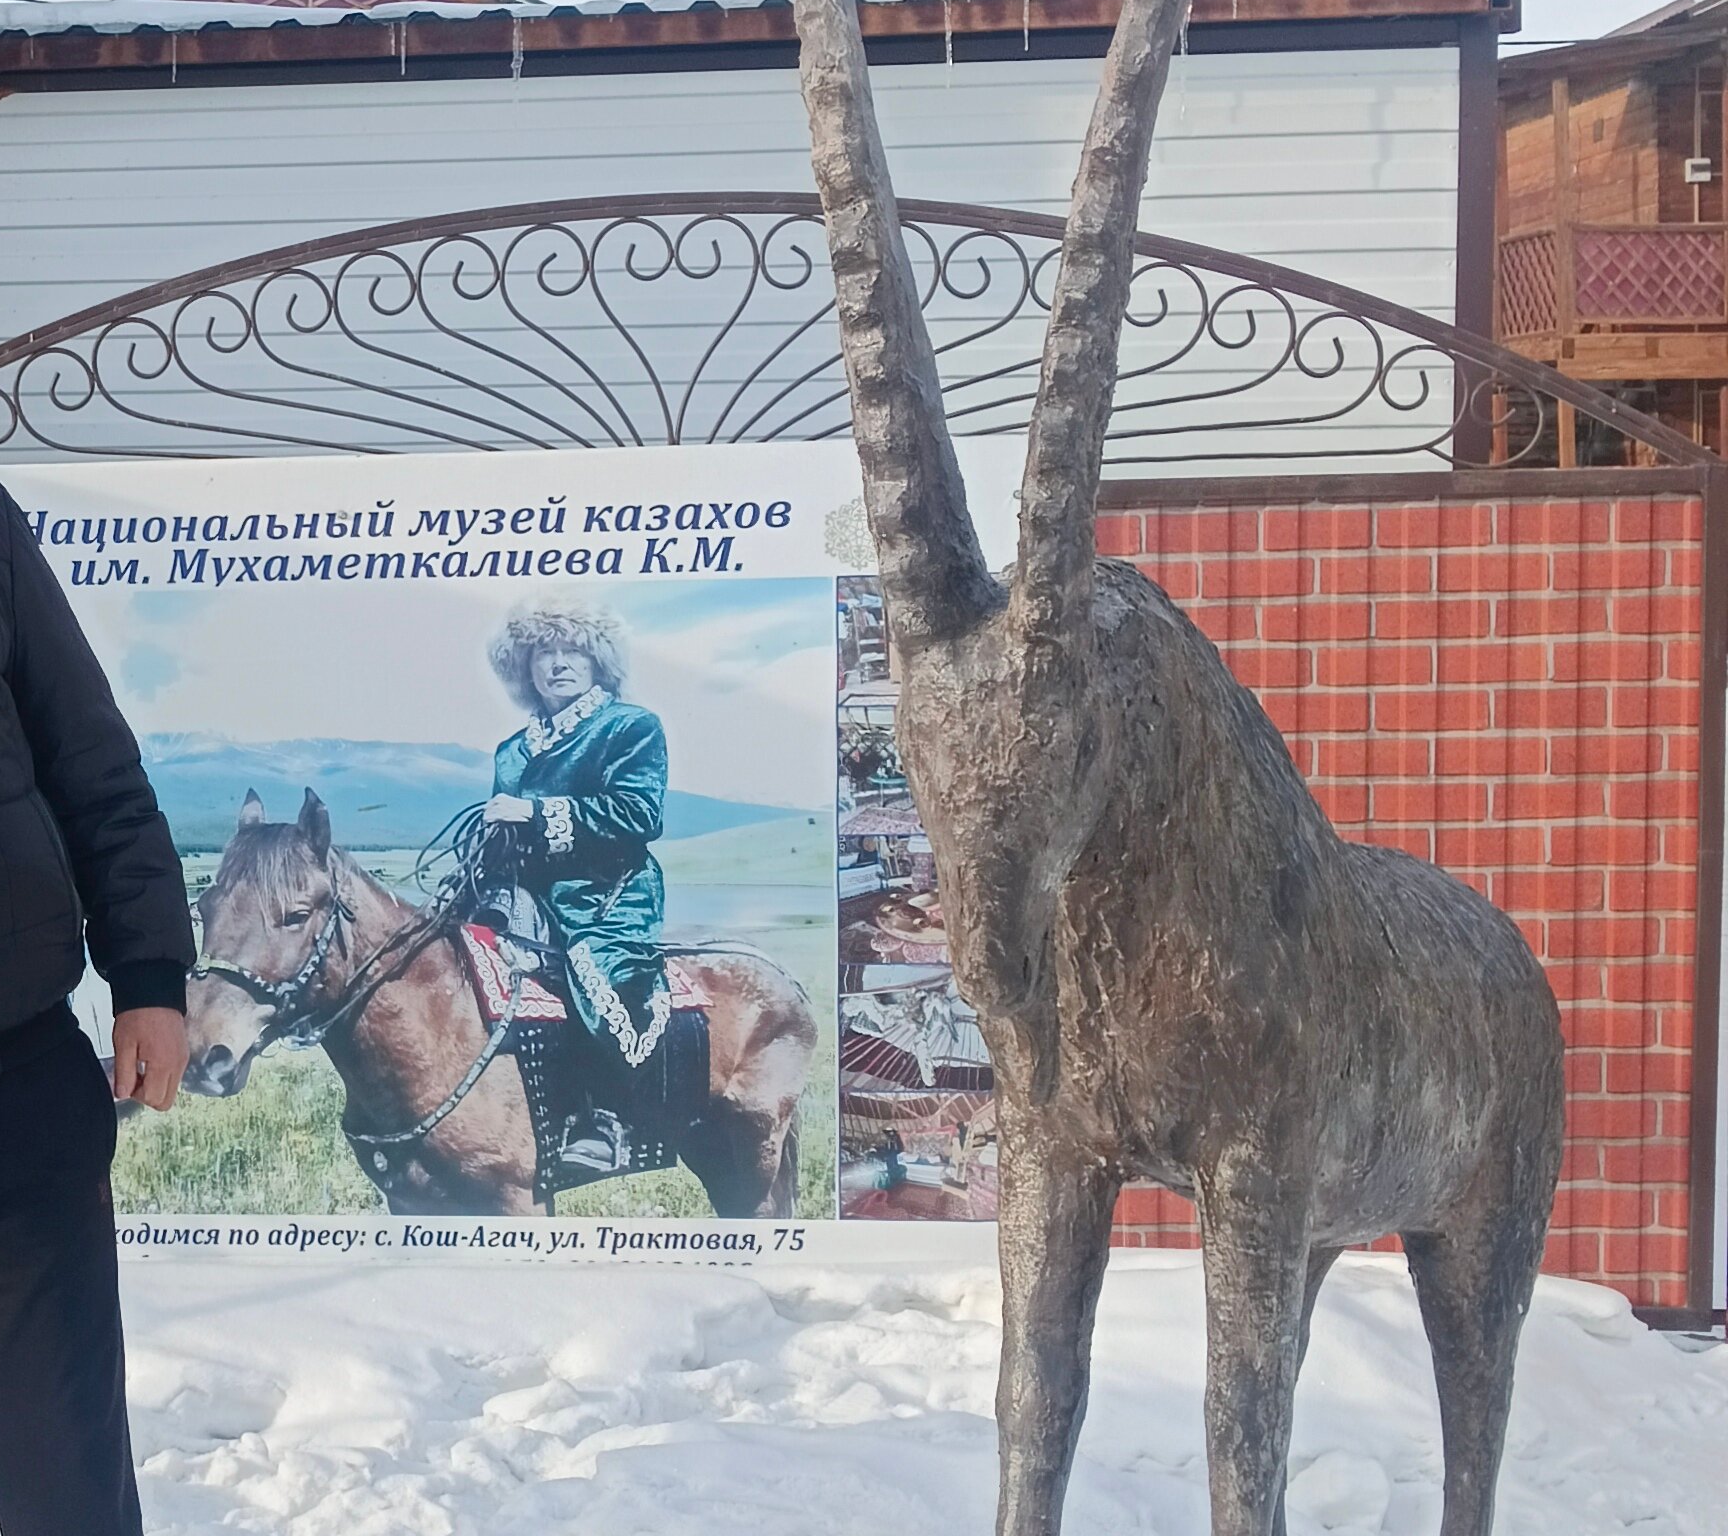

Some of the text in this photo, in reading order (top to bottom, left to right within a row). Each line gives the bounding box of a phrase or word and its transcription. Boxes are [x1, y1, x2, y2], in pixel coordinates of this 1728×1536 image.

[408, 495, 567, 546] музей
[583, 501, 792, 533] казахов
[71, 536, 744, 587] им. Мухаметкалиева К.М.
[228, 1227, 260, 1246] по
[268, 1223, 367, 1252] адресу:
[374, 1229, 393, 1247] с.
[401, 1224, 541, 1252] Кош-Агач,
[546, 1231, 585, 1254] ул.
[596, 1226, 764, 1255] Трактовая,
[773, 1228, 806, 1251] 75
